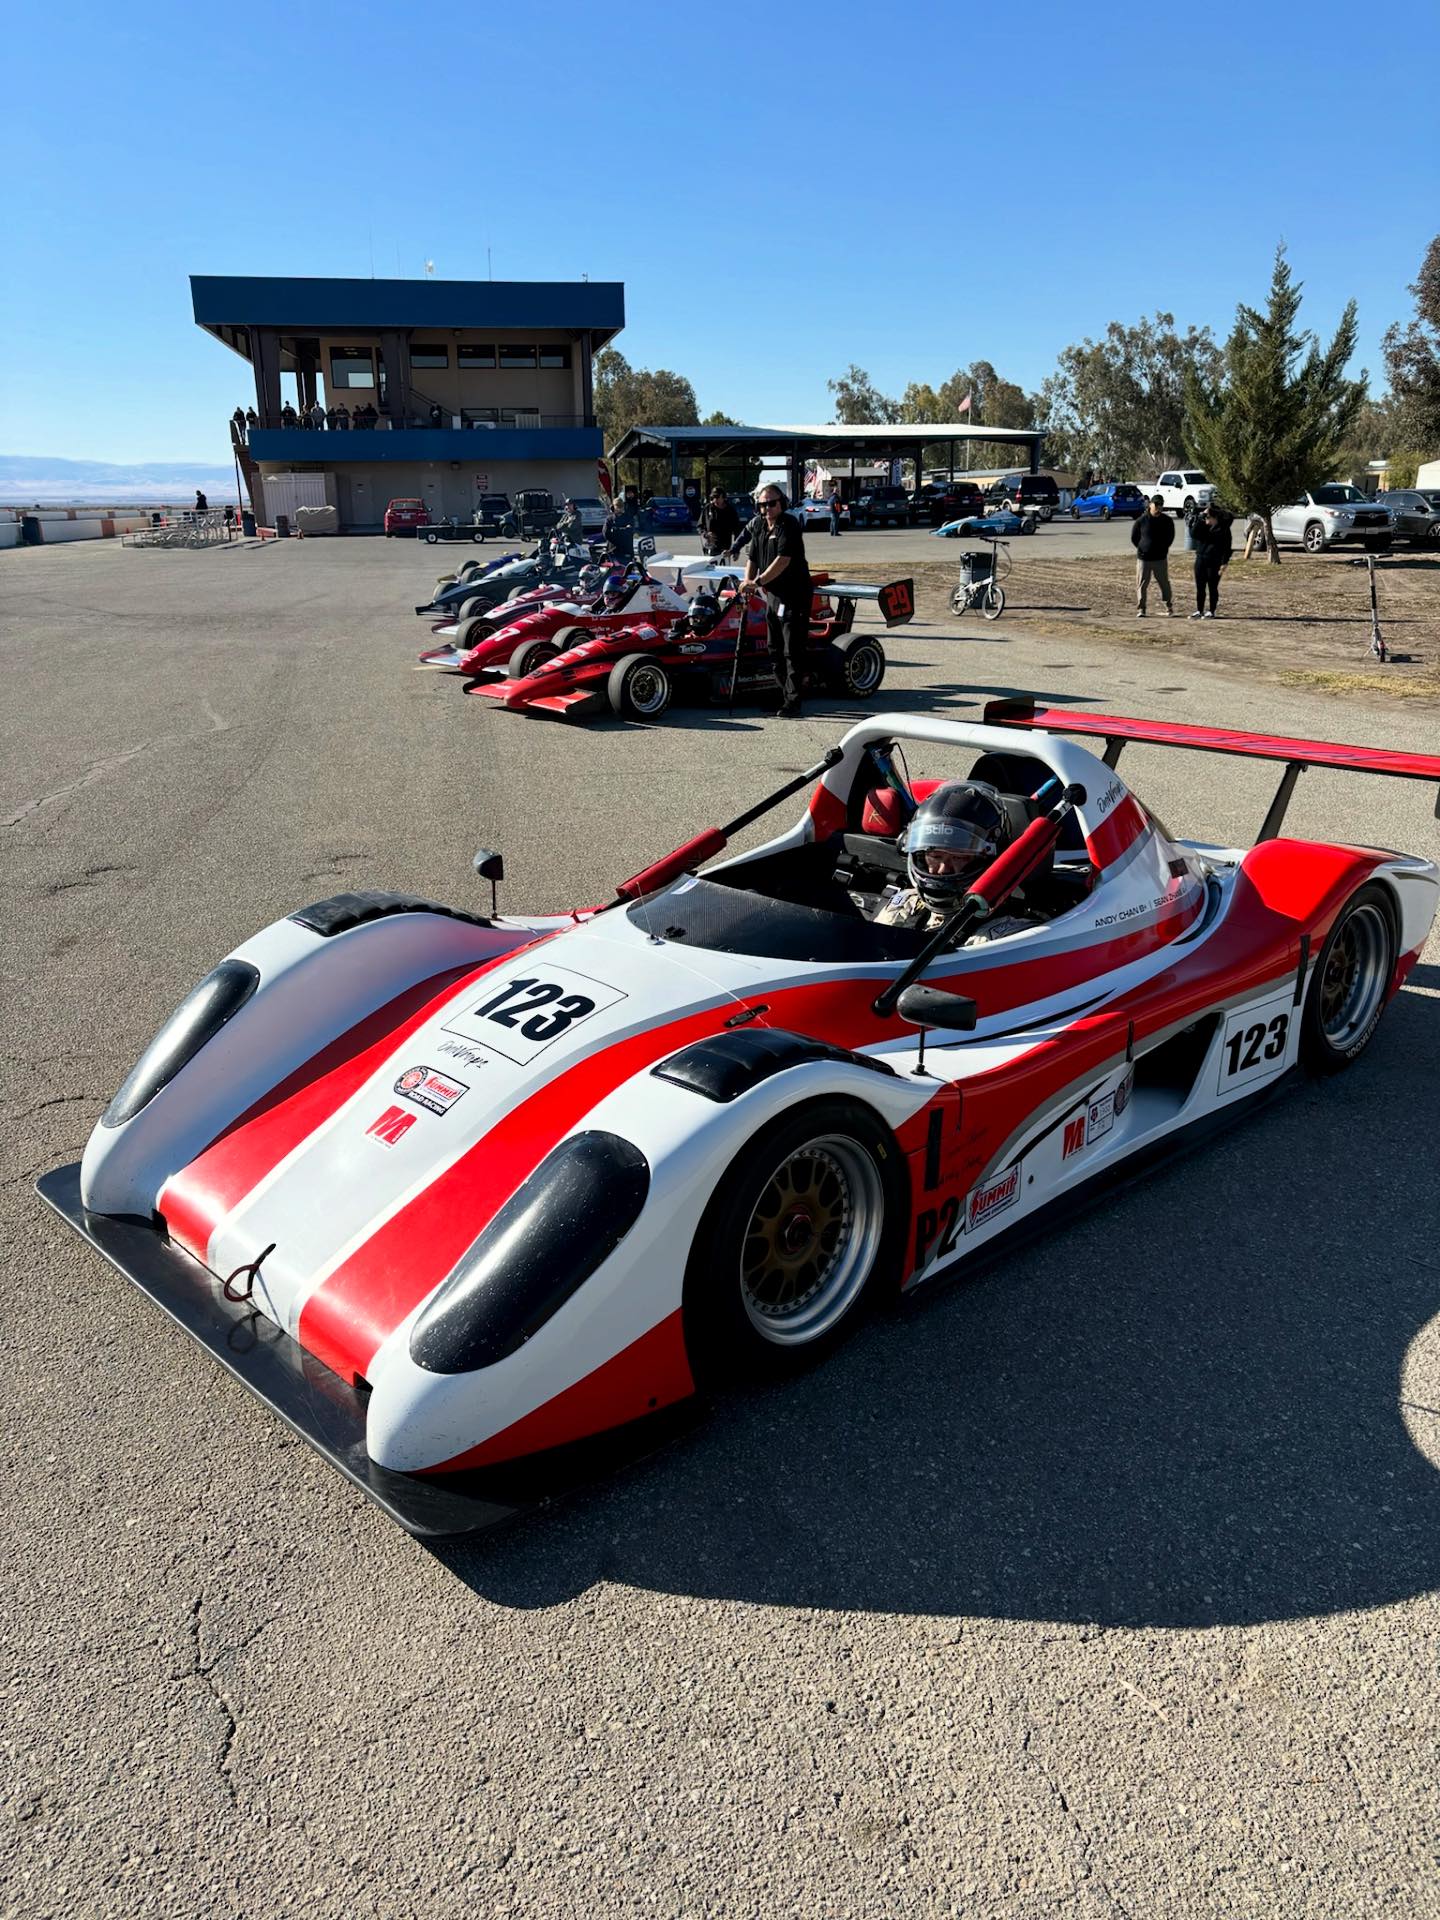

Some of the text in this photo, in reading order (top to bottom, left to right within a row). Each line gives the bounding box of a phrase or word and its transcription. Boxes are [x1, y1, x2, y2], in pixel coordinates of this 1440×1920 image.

[884, 584, 912, 617] 29
[925, 822, 954, 835] stilo
[1095, 913, 1117, 927] ANDY
[1118, 907, 1139, 921] CHAN
[1153, 896, 1168, 907] SEAN
[474, 978, 596, 1042] 123
[1225, 1013, 1289, 1076] 123
[407, 1090, 425, 1101] ROAD
[421, 1098, 446, 1114] RACING
[424, 1075, 461, 1100] SUMMIT
[969, 1165, 1018, 1228] SUMMIT
[914, 1196, 960, 1271] P2
